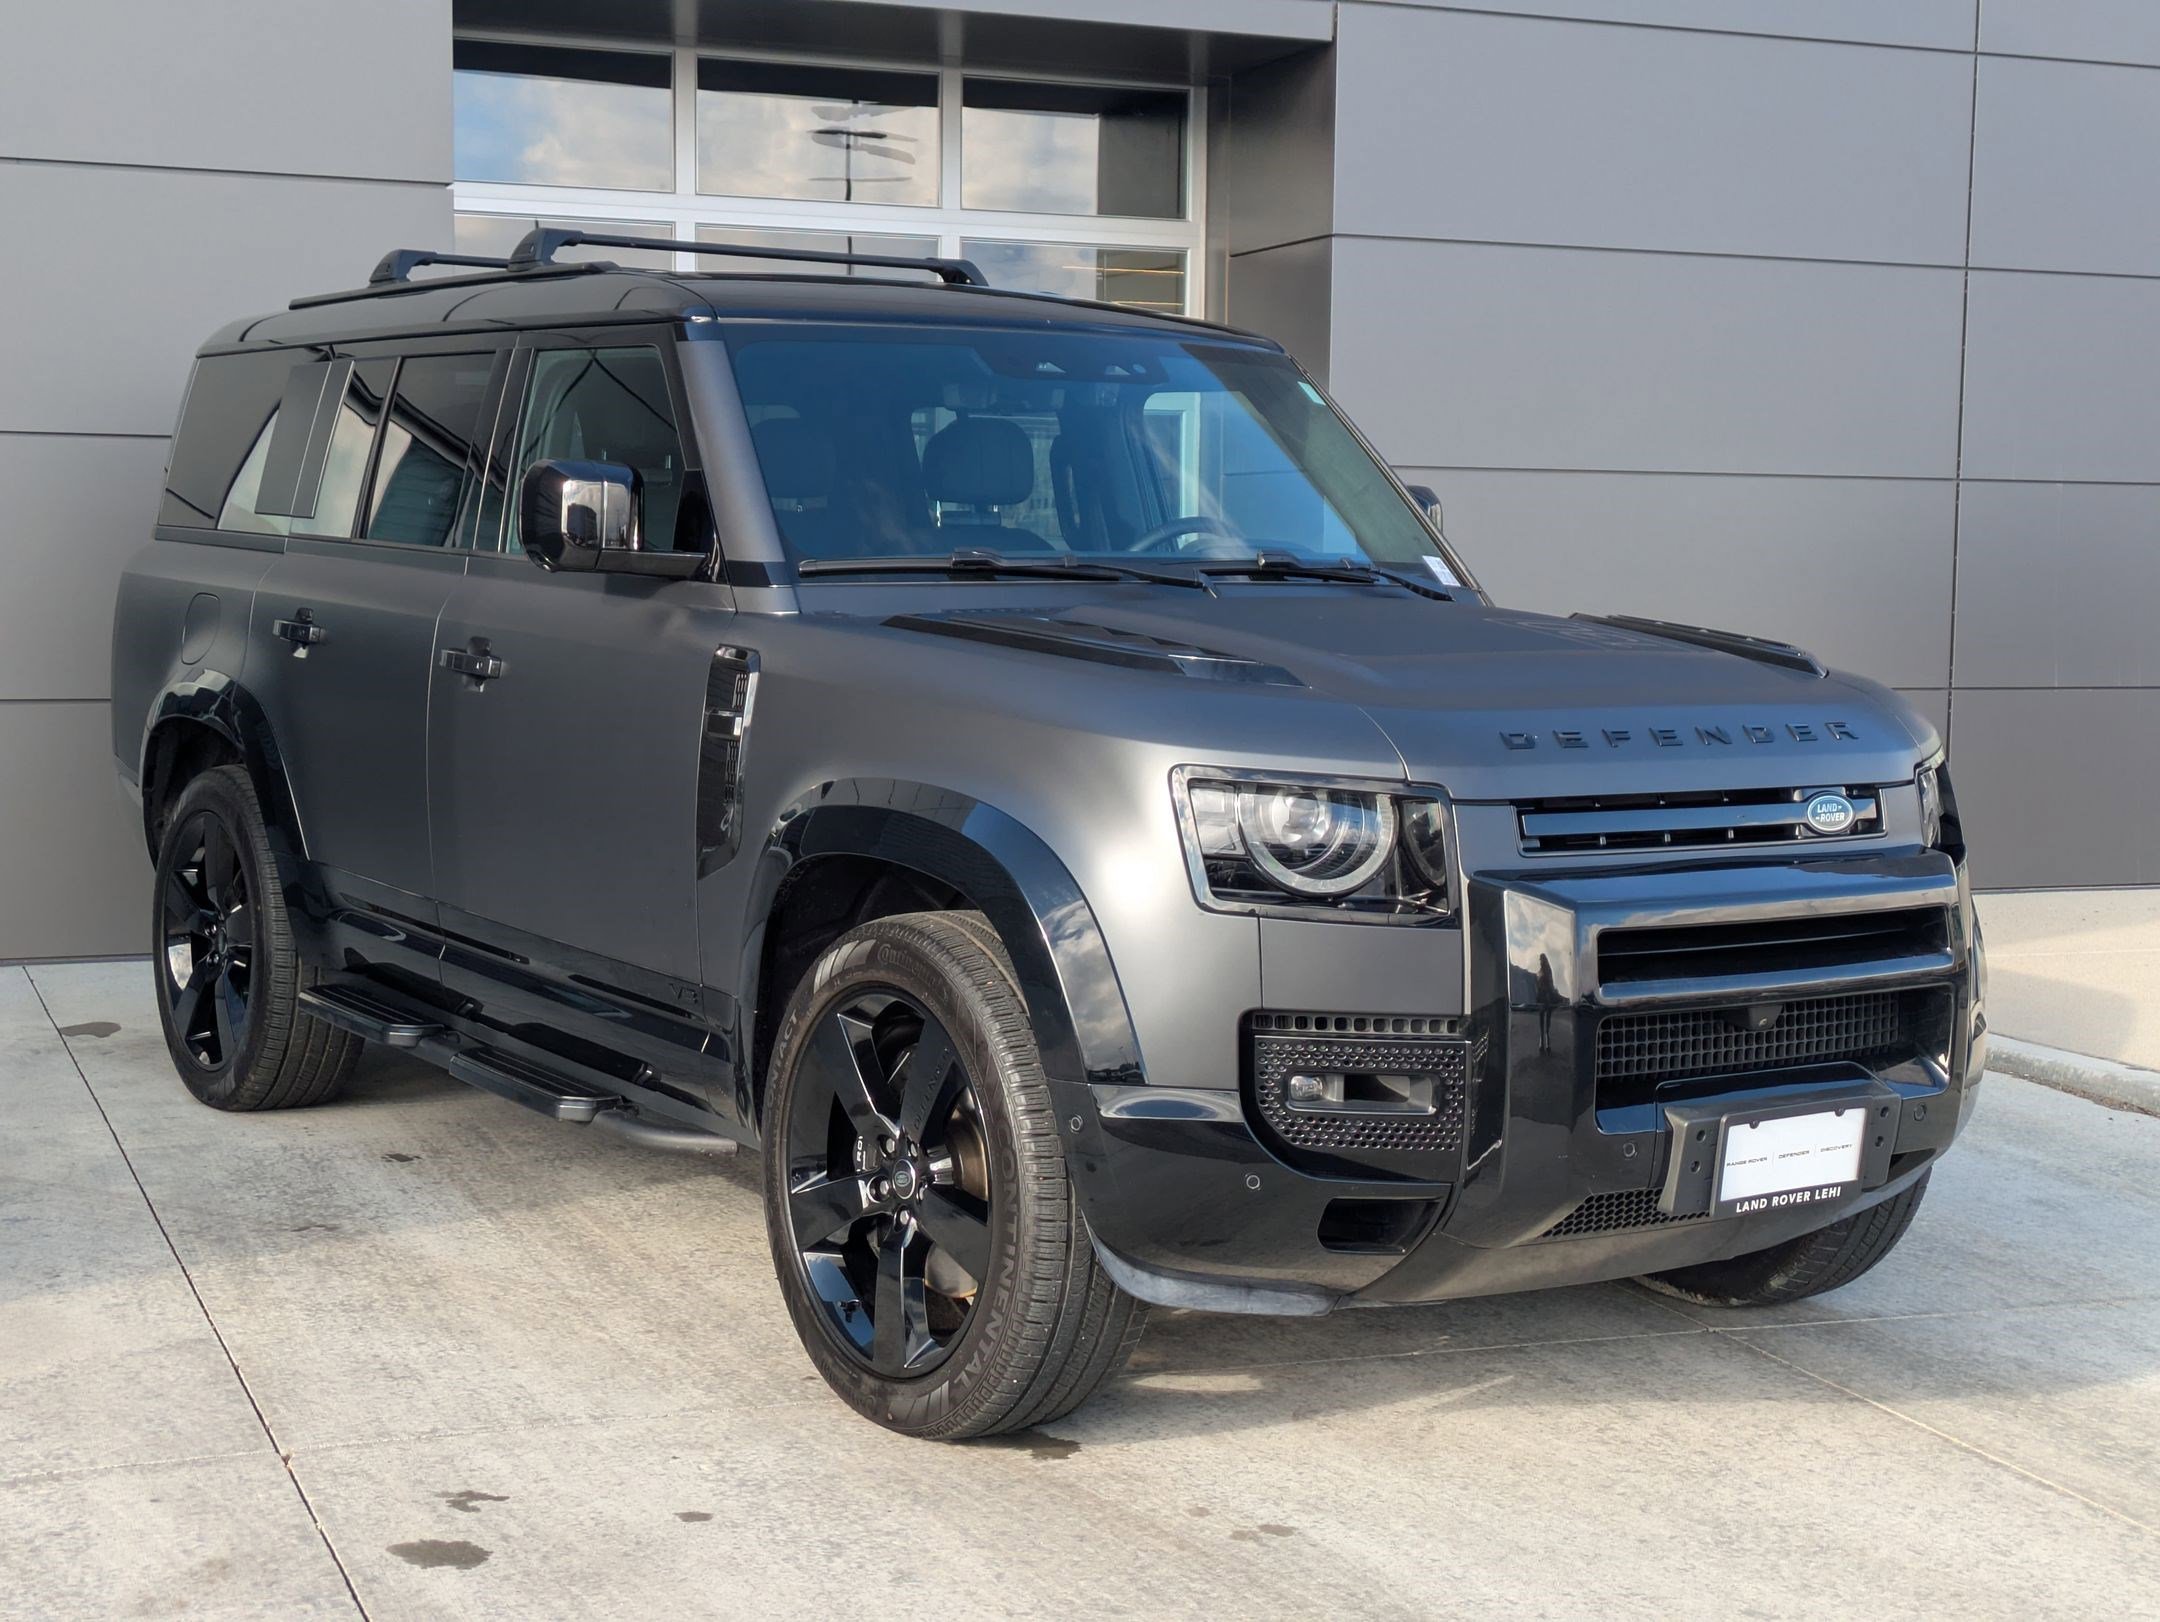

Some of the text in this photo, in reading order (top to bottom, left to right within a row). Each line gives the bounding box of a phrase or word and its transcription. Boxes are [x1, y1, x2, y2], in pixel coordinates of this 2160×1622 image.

[1500, 721, 1859, 750] DEFENDER
[1778, 1150, 1810, 1159] DEFENDER
[1820, 1143, 1853, 1152] DISCOVERY
[1736, 1186, 1841, 1213] LAND ROVER LEHI
